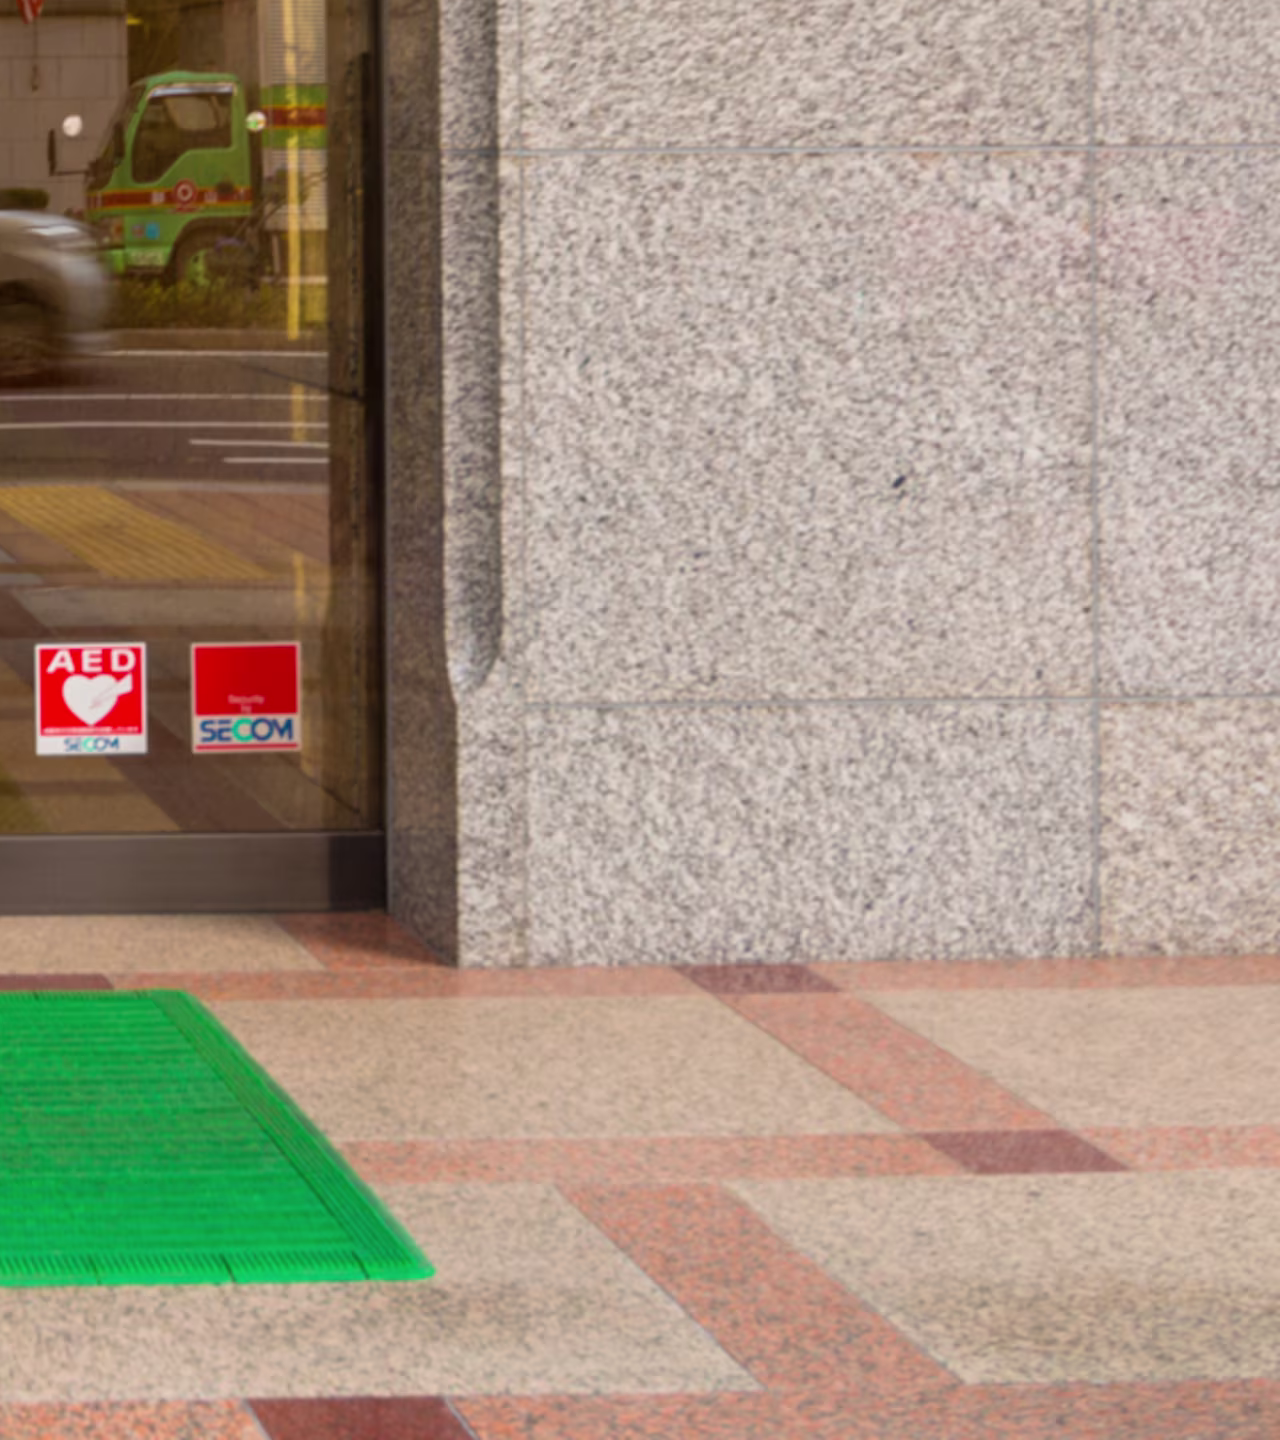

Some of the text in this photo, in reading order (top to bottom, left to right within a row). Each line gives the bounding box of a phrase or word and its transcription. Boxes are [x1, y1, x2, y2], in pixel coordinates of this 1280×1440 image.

[46, 648, 136, 674] AED
[228, 693, 265, 706] Security
[200, 717, 294, 743] SECOM
[64, 736, 120, 752] SECOM
